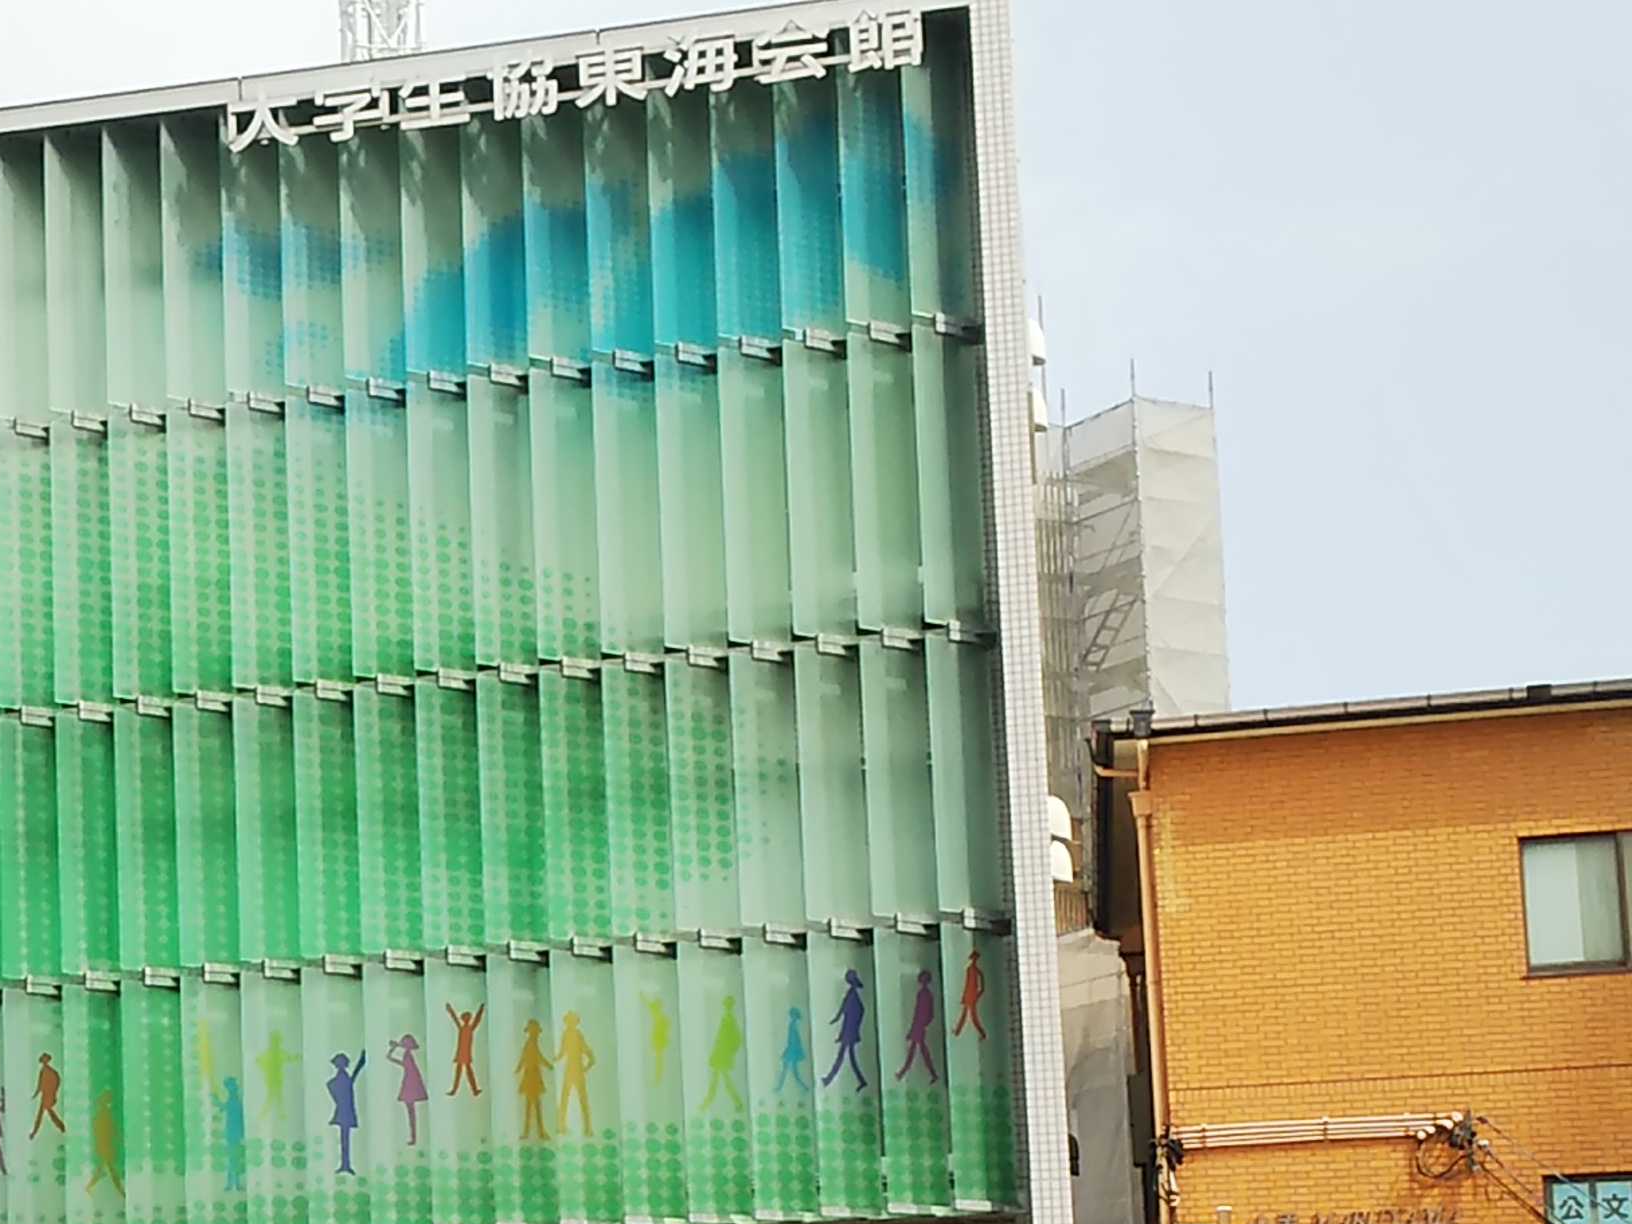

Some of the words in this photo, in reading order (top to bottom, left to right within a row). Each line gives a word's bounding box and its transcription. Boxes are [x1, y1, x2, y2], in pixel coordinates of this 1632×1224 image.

[227, 8, 925, 154] 大学生協東海会館
[1558, 1193, 1630, 1220] 公文
